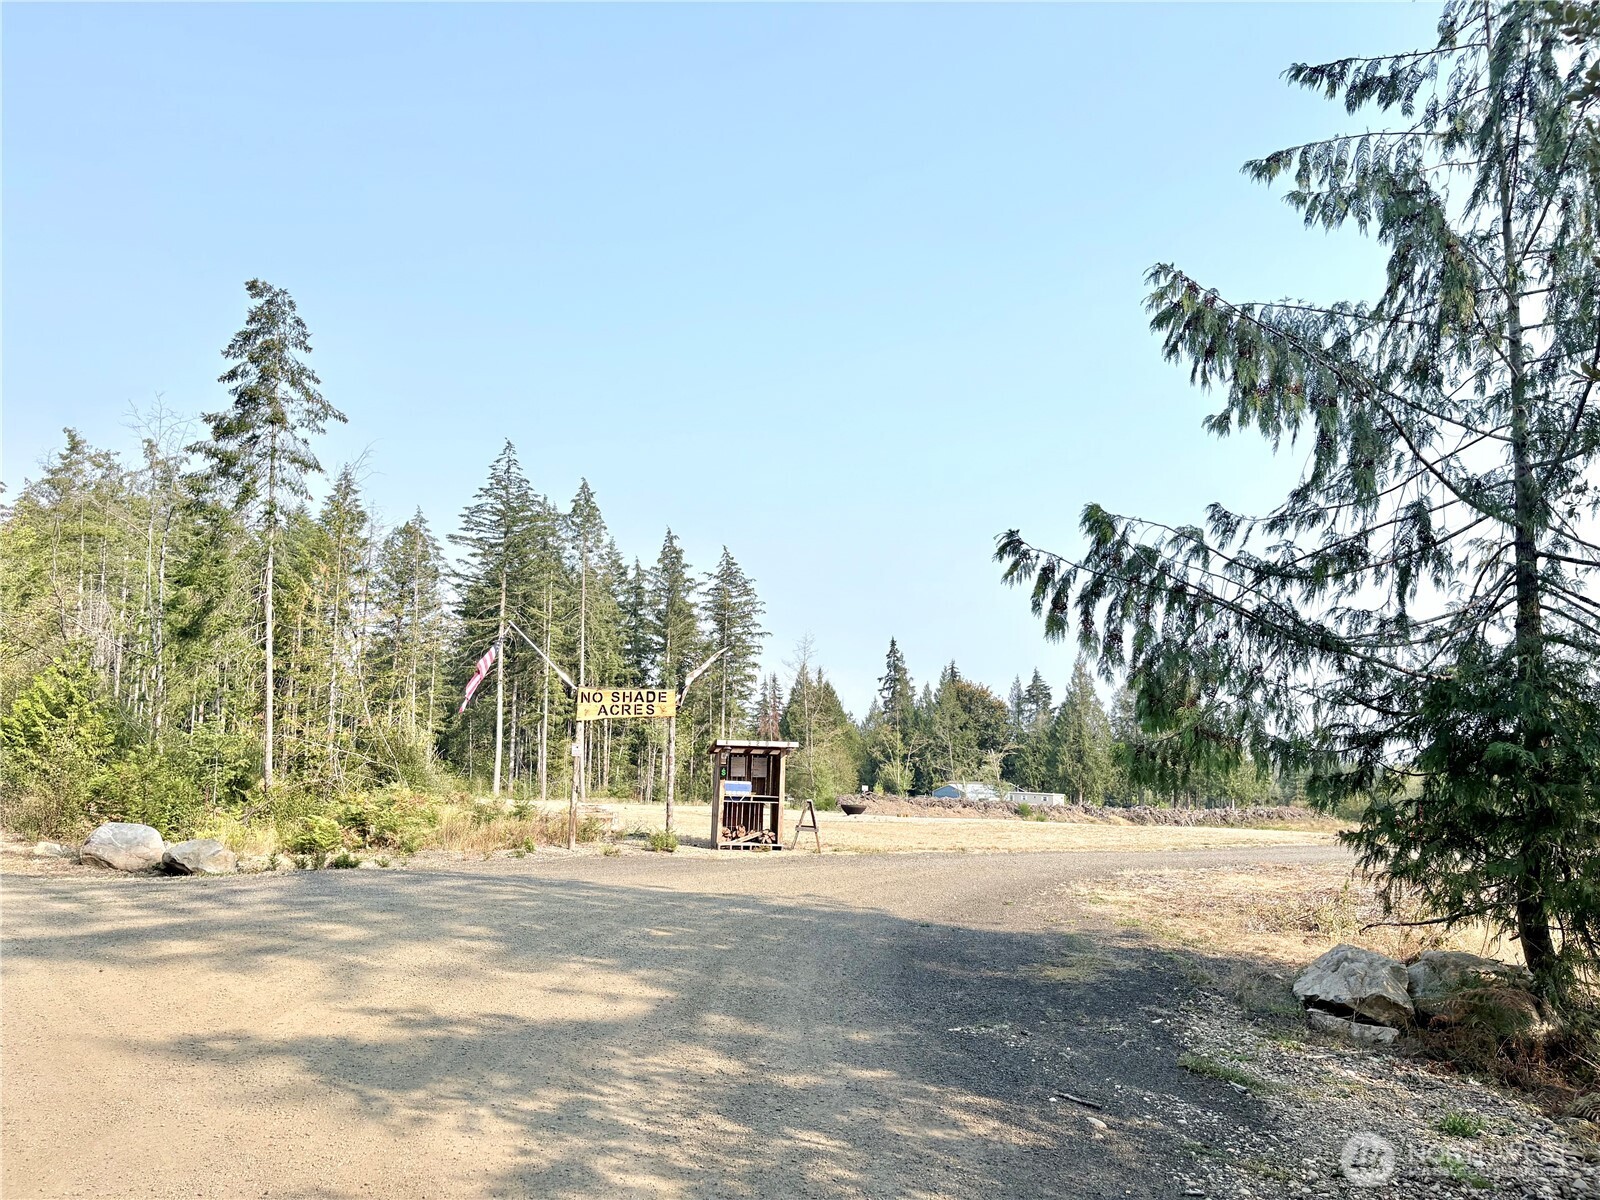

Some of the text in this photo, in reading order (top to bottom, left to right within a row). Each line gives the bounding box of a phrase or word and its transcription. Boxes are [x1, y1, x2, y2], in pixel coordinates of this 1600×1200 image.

[580, 691, 668, 704] NO SHADE
[597, 704, 655, 716] ACRES
